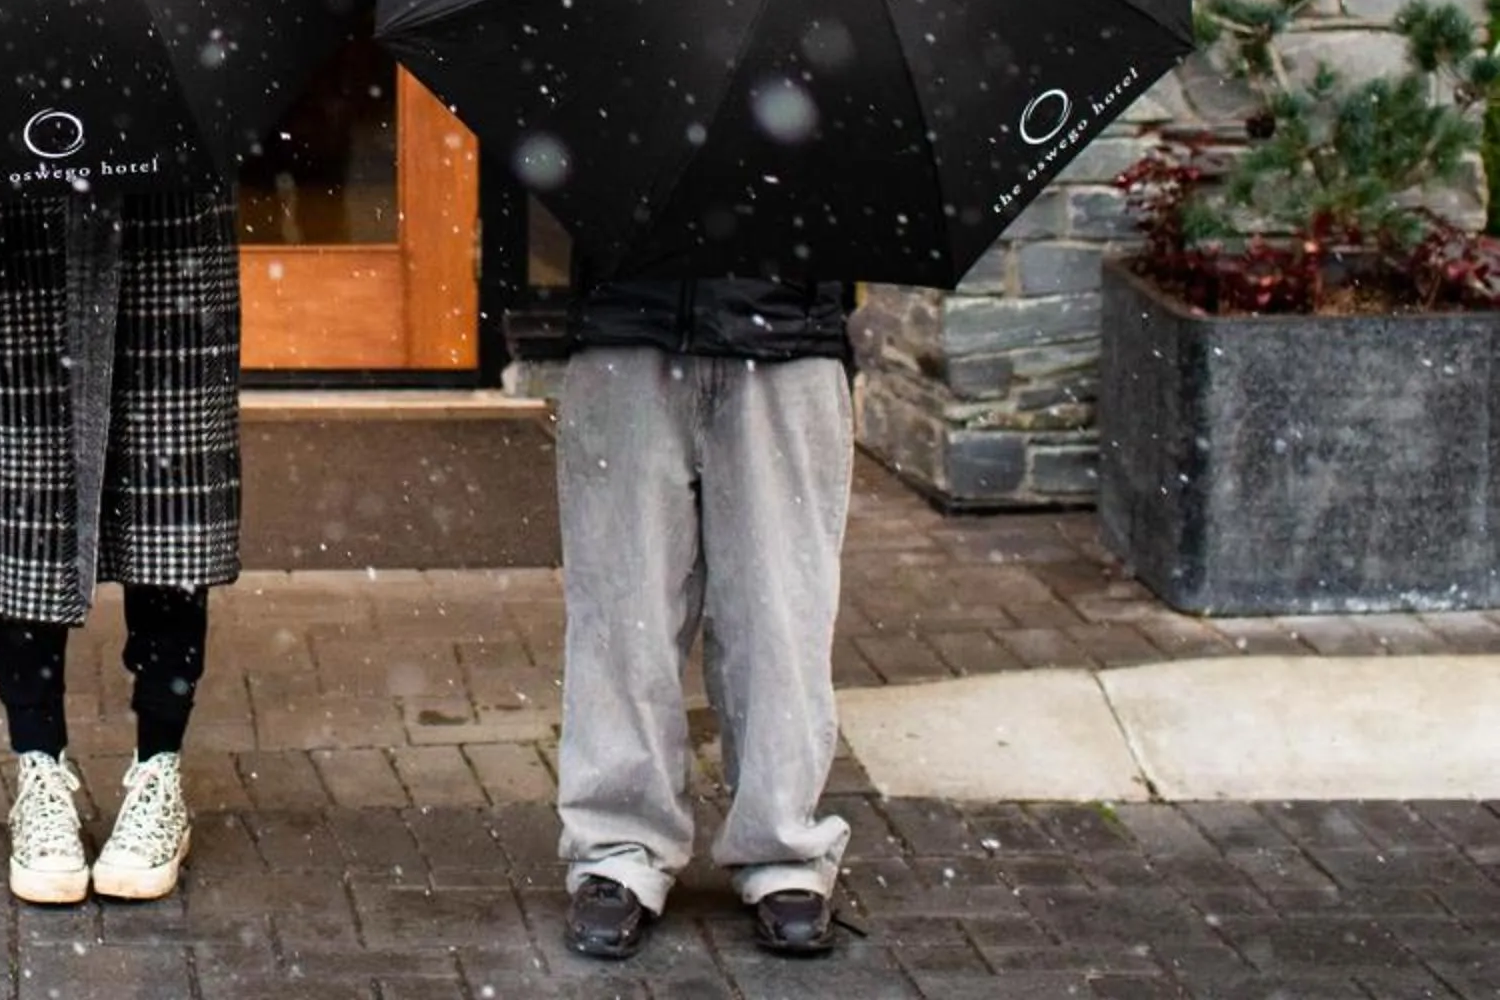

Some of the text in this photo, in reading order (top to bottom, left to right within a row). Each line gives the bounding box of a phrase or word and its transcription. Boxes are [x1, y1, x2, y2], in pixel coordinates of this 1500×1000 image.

[9, 165, 91, 184] oswego
[101, 156, 158, 176] hotel
[993, 66, 1139, 213] the oswego hotel
